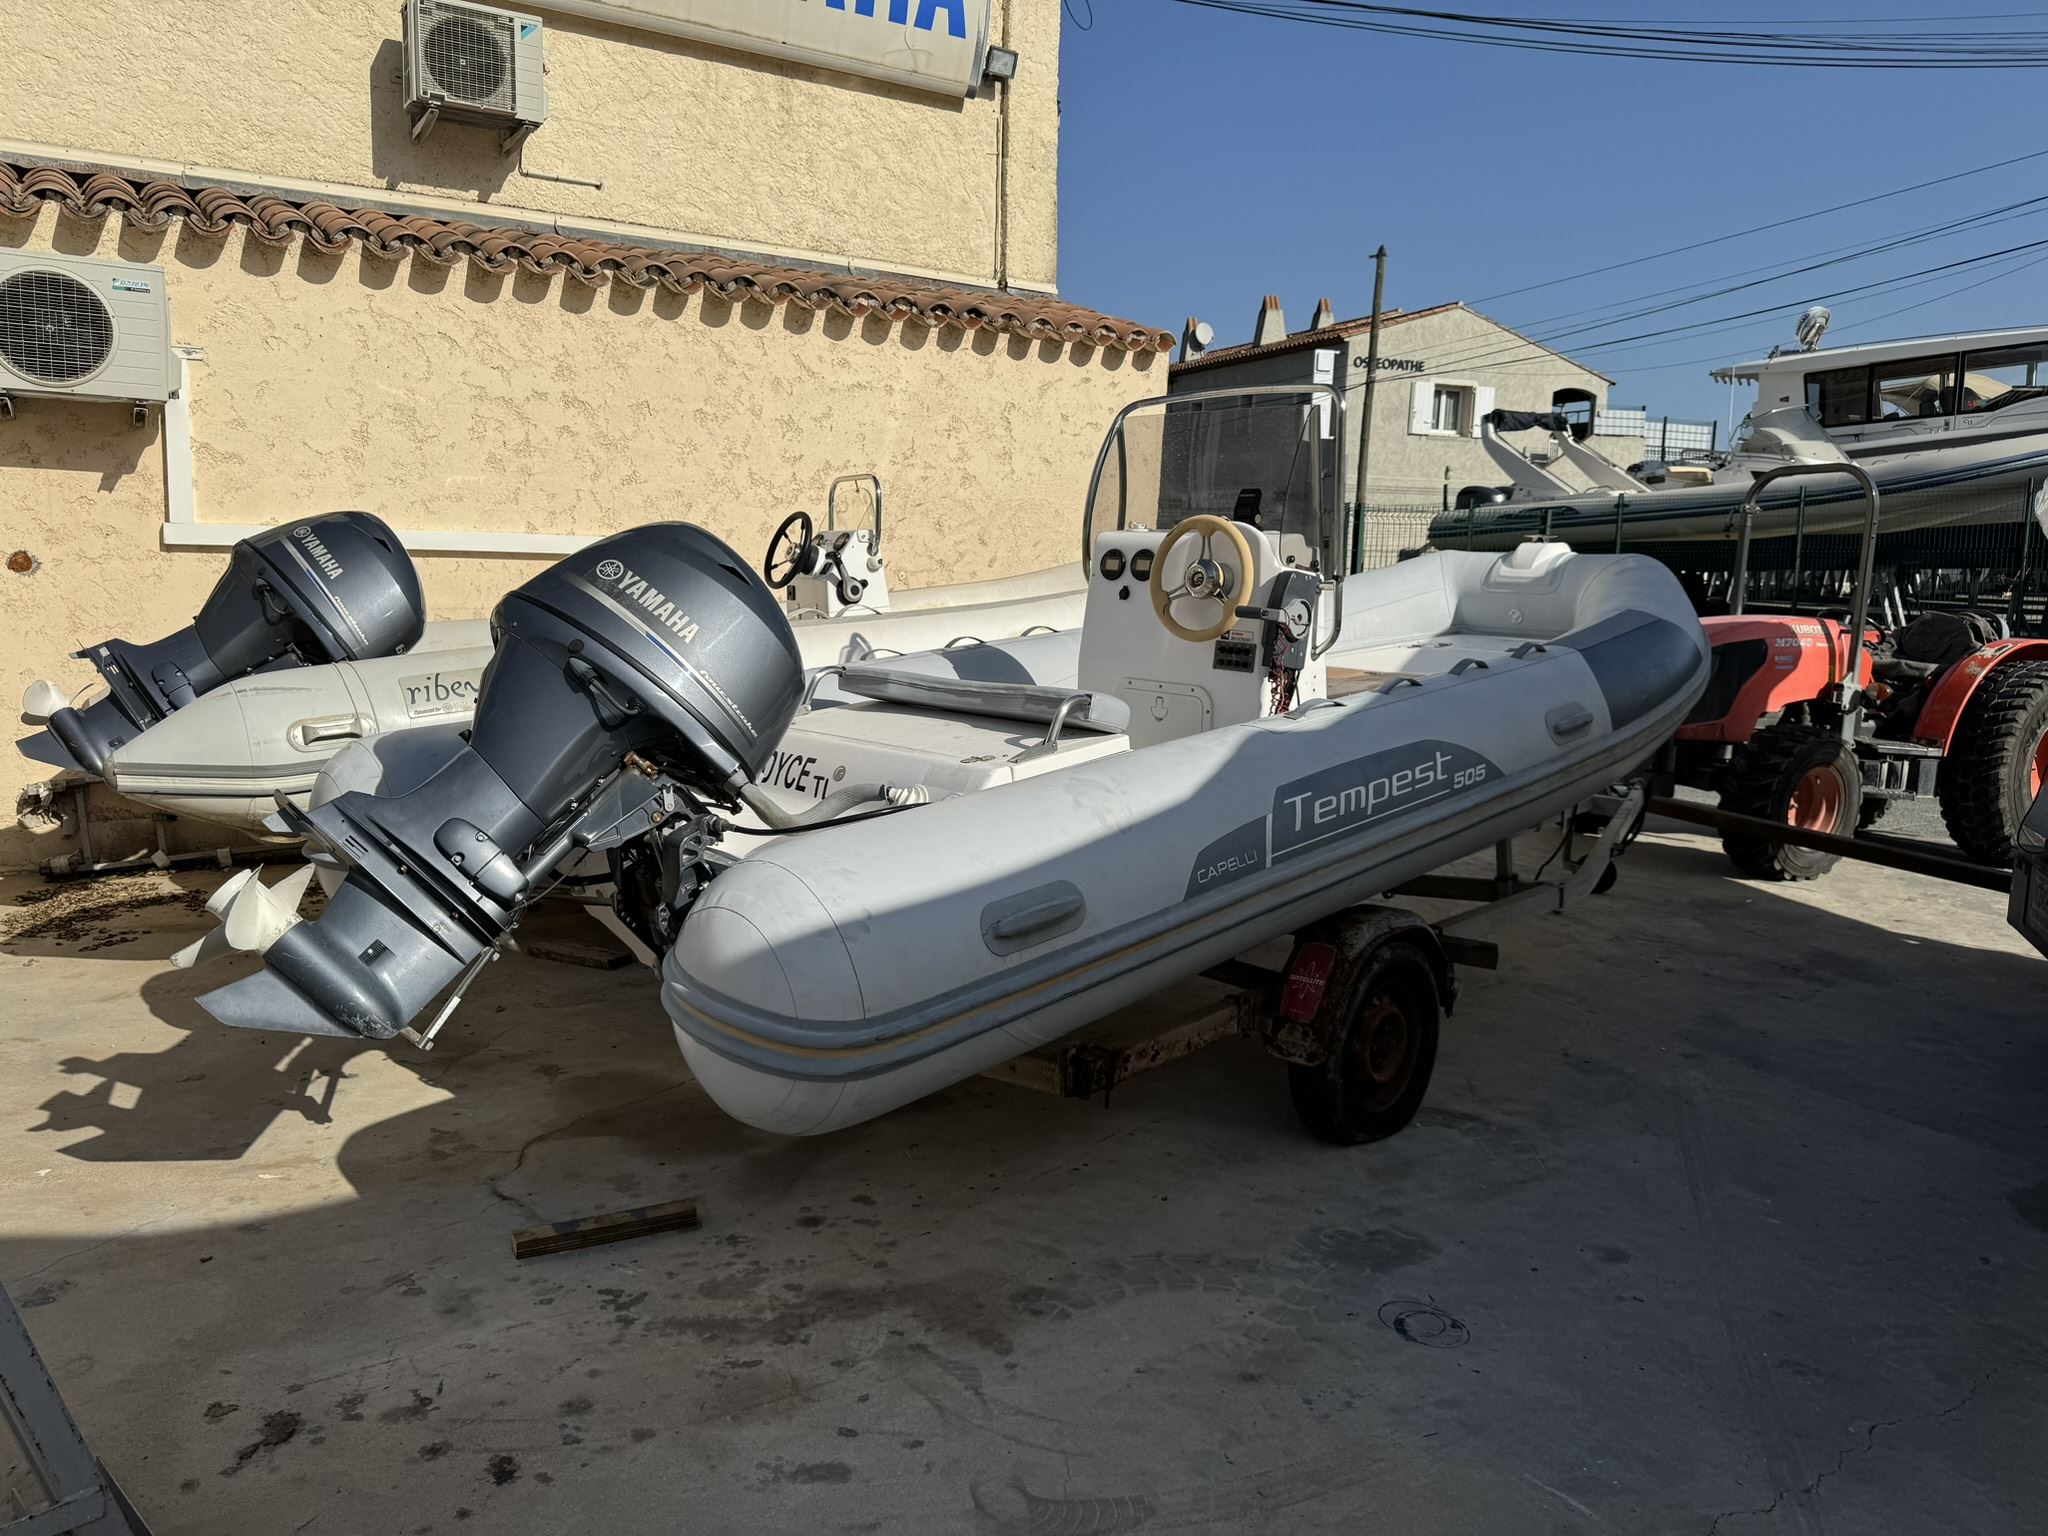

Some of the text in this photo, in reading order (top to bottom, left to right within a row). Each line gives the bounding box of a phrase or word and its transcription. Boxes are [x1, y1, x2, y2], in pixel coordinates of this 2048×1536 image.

[1353, 356, 1425, 372] OSEOPATHE
[301, 533, 344, 580] YAMAHA
[617, 570, 700, 644] YAMAHA
[1283, 750, 1487, 832] Tempest 505
[1197, 849, 1258, 884] CAPELLI
